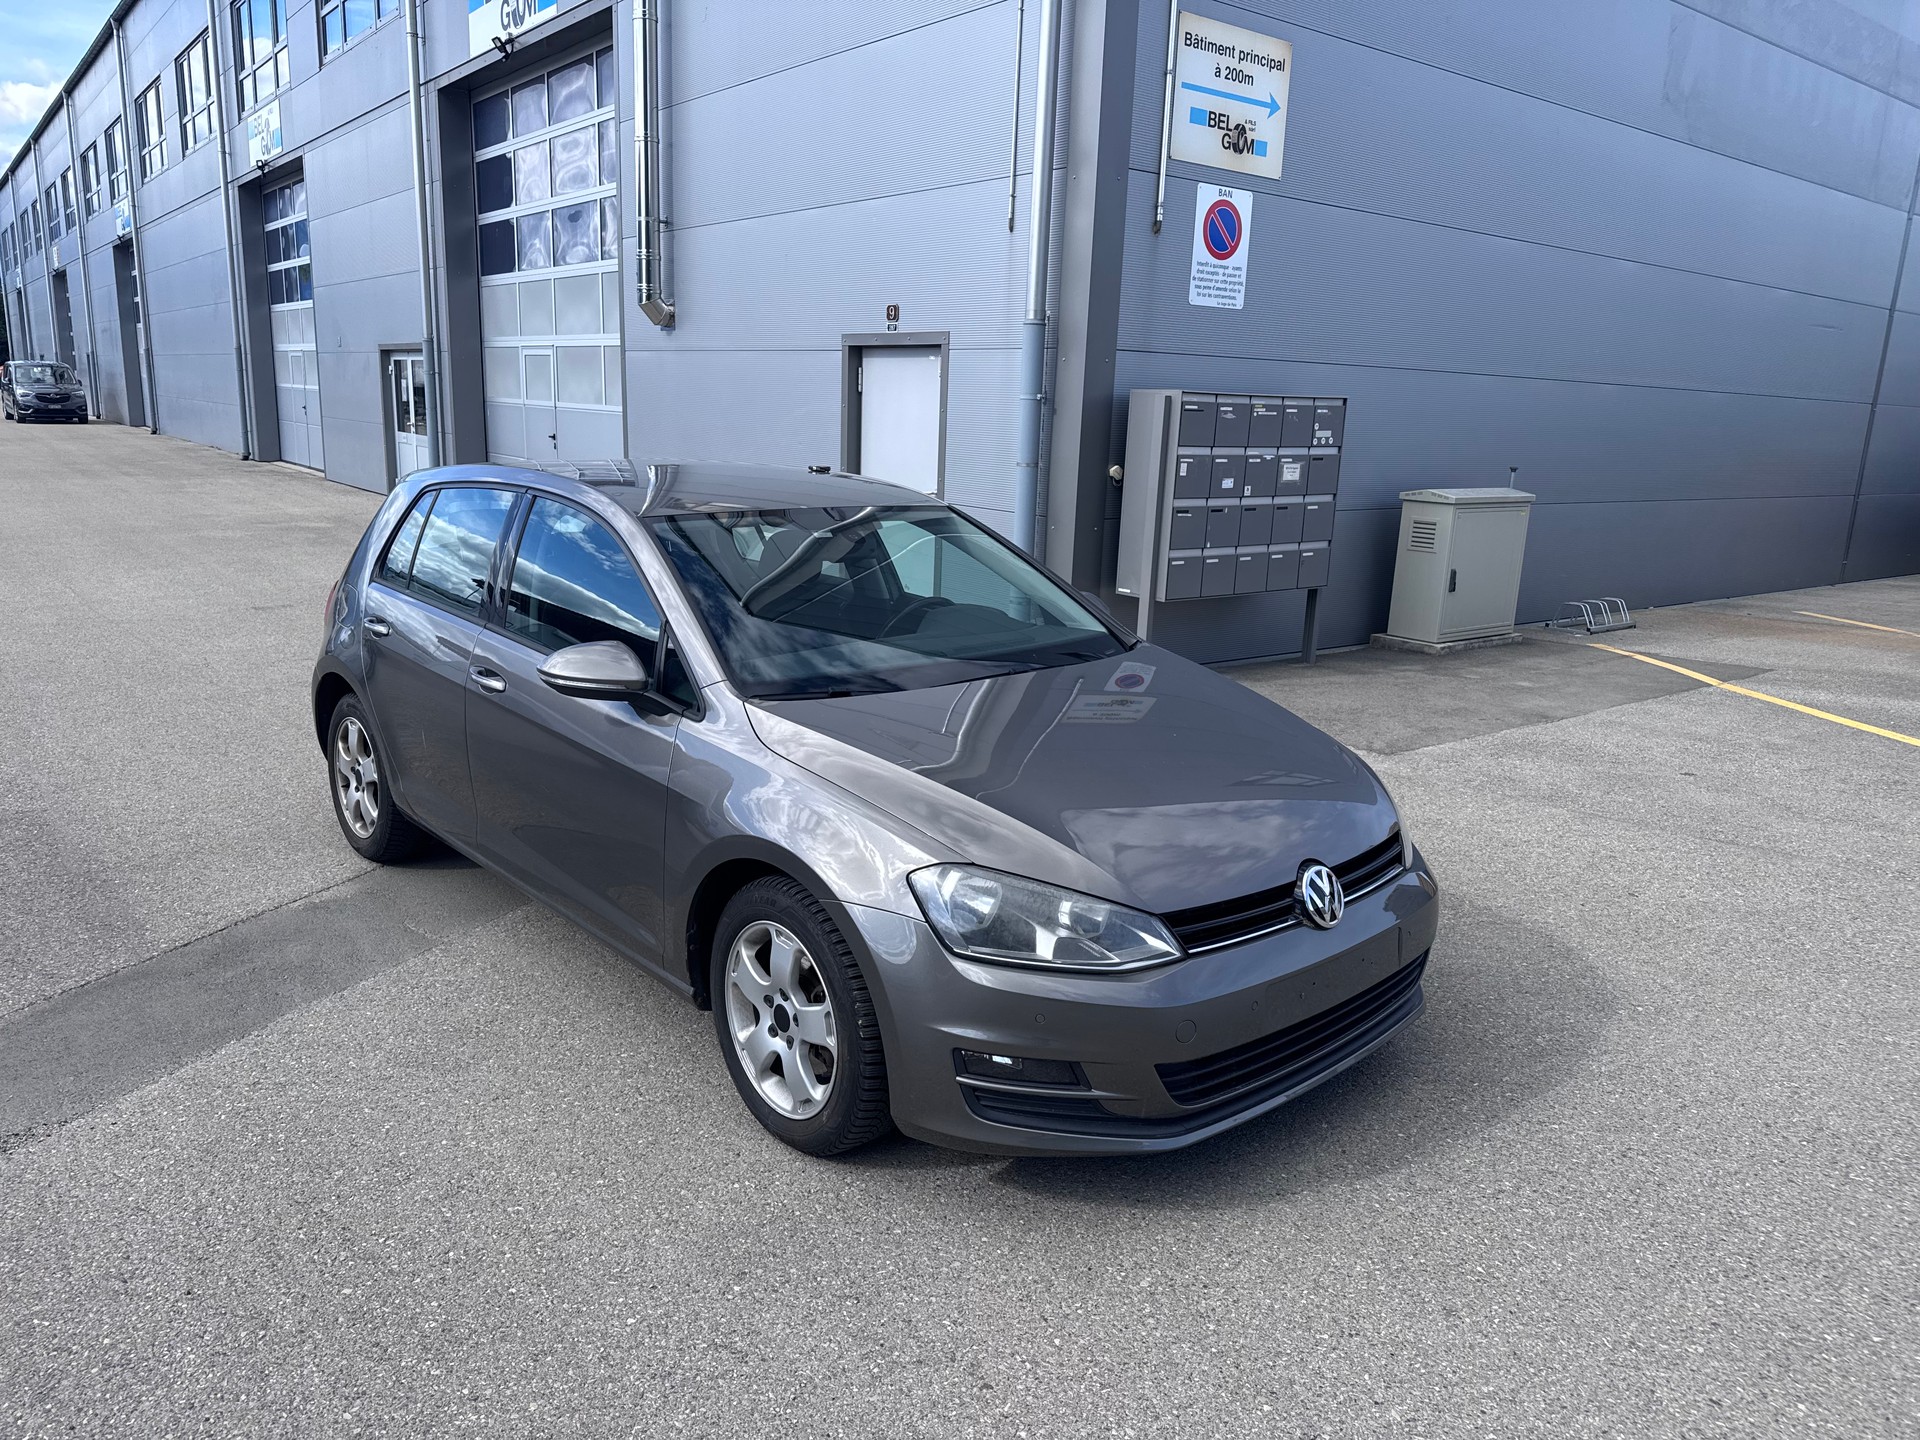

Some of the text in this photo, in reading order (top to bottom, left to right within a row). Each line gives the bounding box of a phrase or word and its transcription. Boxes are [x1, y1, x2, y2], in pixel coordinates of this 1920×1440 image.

[1184, 31, 1286, 73] Bâtiment principal
[1215, 62, 1254, 86] à 200m
[1218, 188, 1233, 199] BAN
[889, 306, 895, 319] 9
